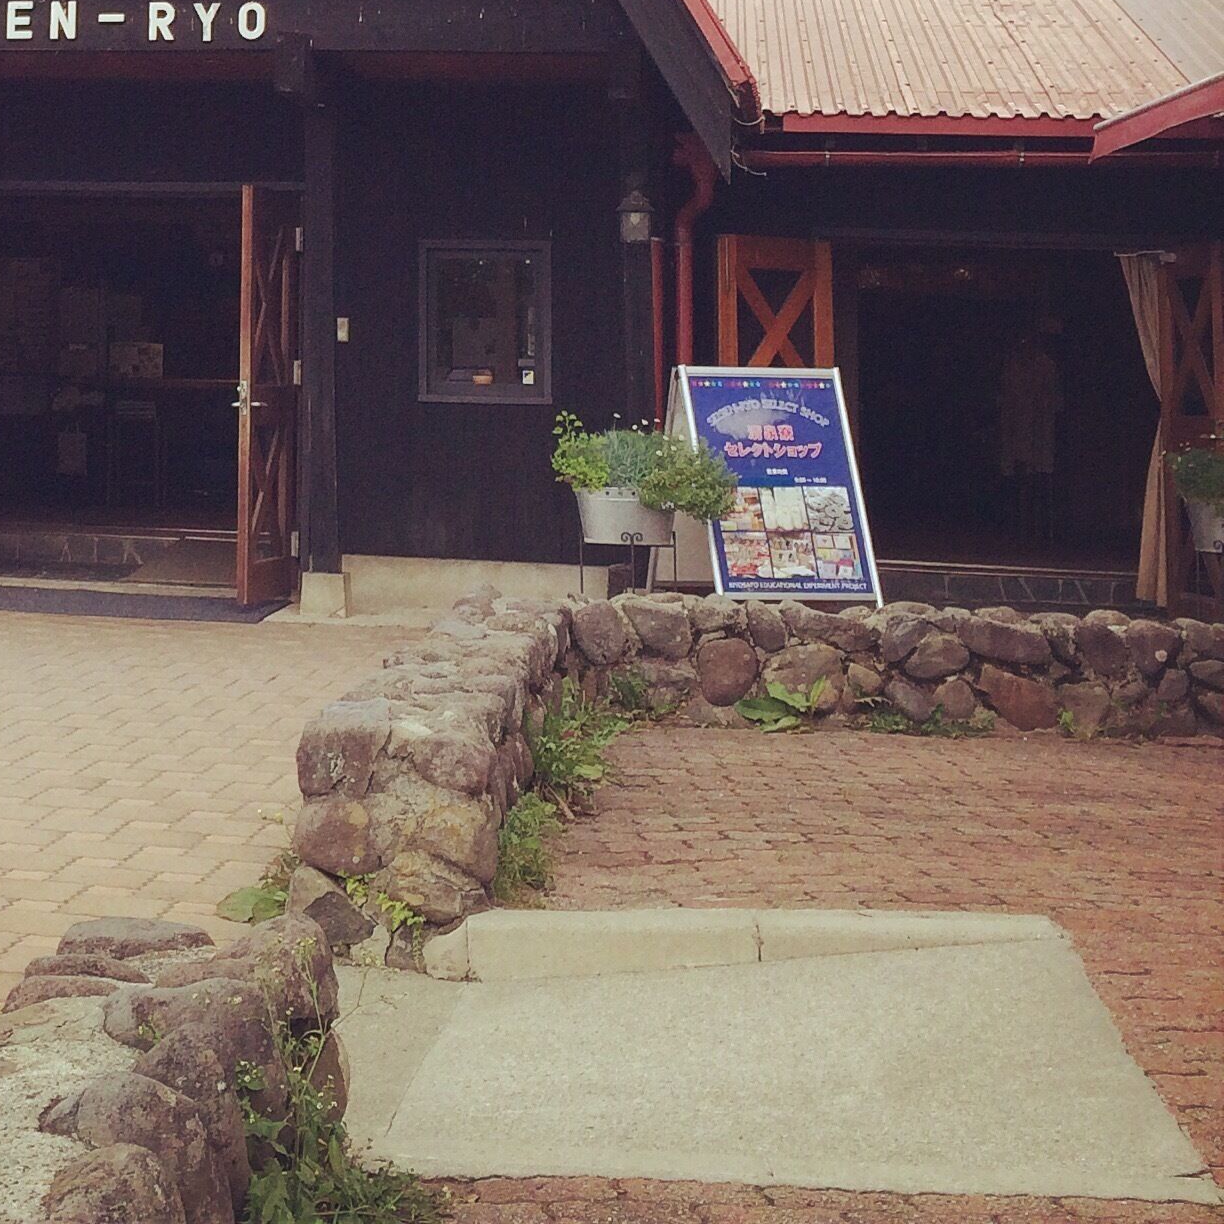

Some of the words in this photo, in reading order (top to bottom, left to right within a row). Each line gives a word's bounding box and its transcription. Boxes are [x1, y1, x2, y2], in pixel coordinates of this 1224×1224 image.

[799, 406, 830, 427] SHOP
[724, 441, 822, 458] セレクトショップ
